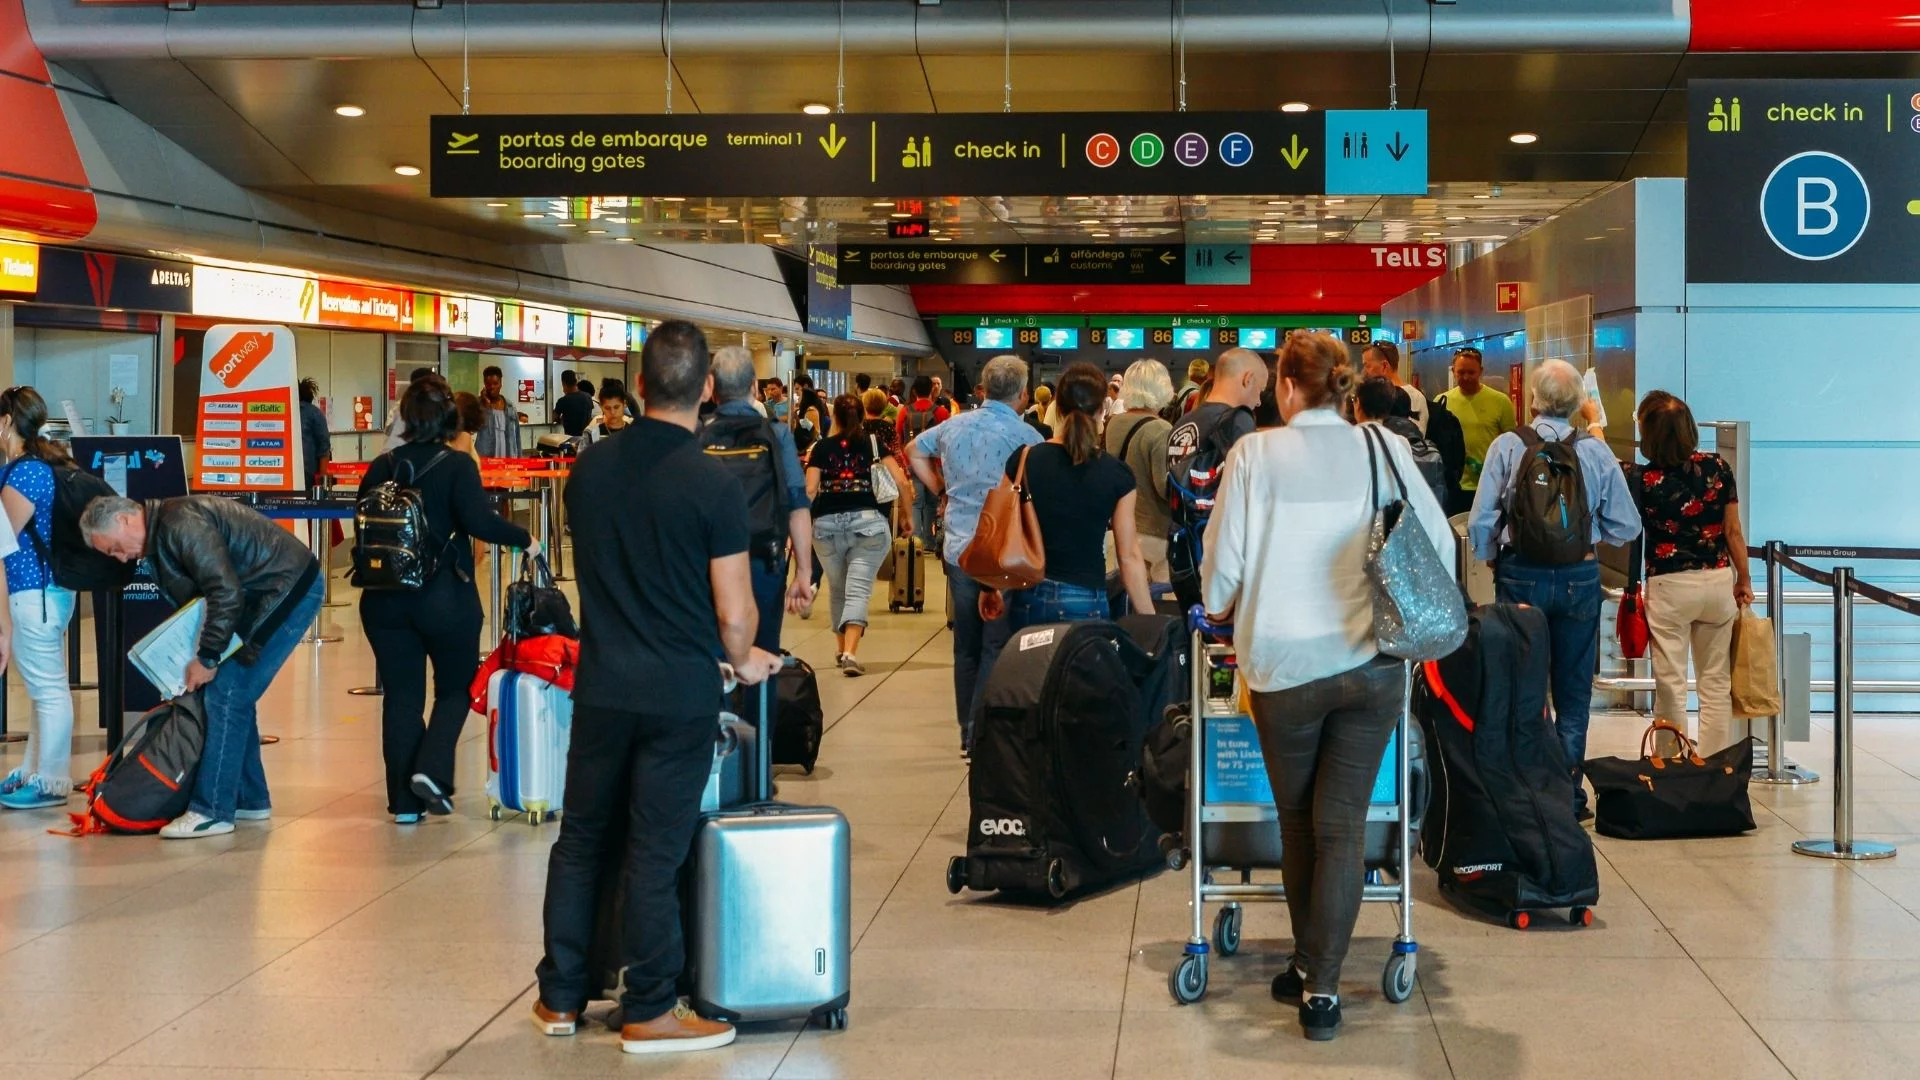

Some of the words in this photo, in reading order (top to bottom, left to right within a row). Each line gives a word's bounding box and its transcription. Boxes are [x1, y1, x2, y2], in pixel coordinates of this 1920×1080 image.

[1766, 102, 1836, 122] check
[1843, 102, 1863, 121] in
[499, 131, 565, 151] portas
[570, 130, 596, 148] de
[602, 130, 708, 151] embarque
[727, 131, 793, 146] terminal
[796, 132, 803, 146] 1
[954, 140, 1016, 160] check
[1021, 141, 1041, 159] in
[1095, 140, 1110, 160] C
[1141, 141, 1156, 160] D
[1185, 140, 1199, 160] E
[1230, 140, 1243, 160] F
[499, 152, 586, 172] boarding
[591, 154, 646, 172] gates
[1797, 176, 1839, 236] B
[870, 251, 905, 262] portas
[907, 251, 921, 260] de
[923, 250, 979, 262] embarque
[1070, 250, 1125, 263] alfândega
[1371, 247, 1422, 267] Tell
[870, 261, 916, 272] boarding
[918, 263, 947, 273] gates
[1070, 261, 1113, 270] customs
[158, 270, 184, 286] DELTA
[321, 291, 361, 314] Reservations
[360, 297, 372, 315] and
[372, 298, 399, 322] Ticketing
[953, 331, 973, 344] 89
[1020, 331, 1039, 343] 88
[1153, 331, 1172, 343] 86
[1219, 331, 1238, 344] 85
[1351, 331, 1370, 344] 83
[216, 336, 259, 384] portway
[250, 404, 281, 413] airBaltic
[249, 457, 280, 466] orbest!
[1795, 548, 1831, 556] Lufthansa
[1832, 549, 1857, 557] Group
[1217, 740, 1226, 748] In
[1217, 761, 1230, 769] for
[1231, 761, 1243, 769] 75
[980, 819, 1023, 836] evoc
